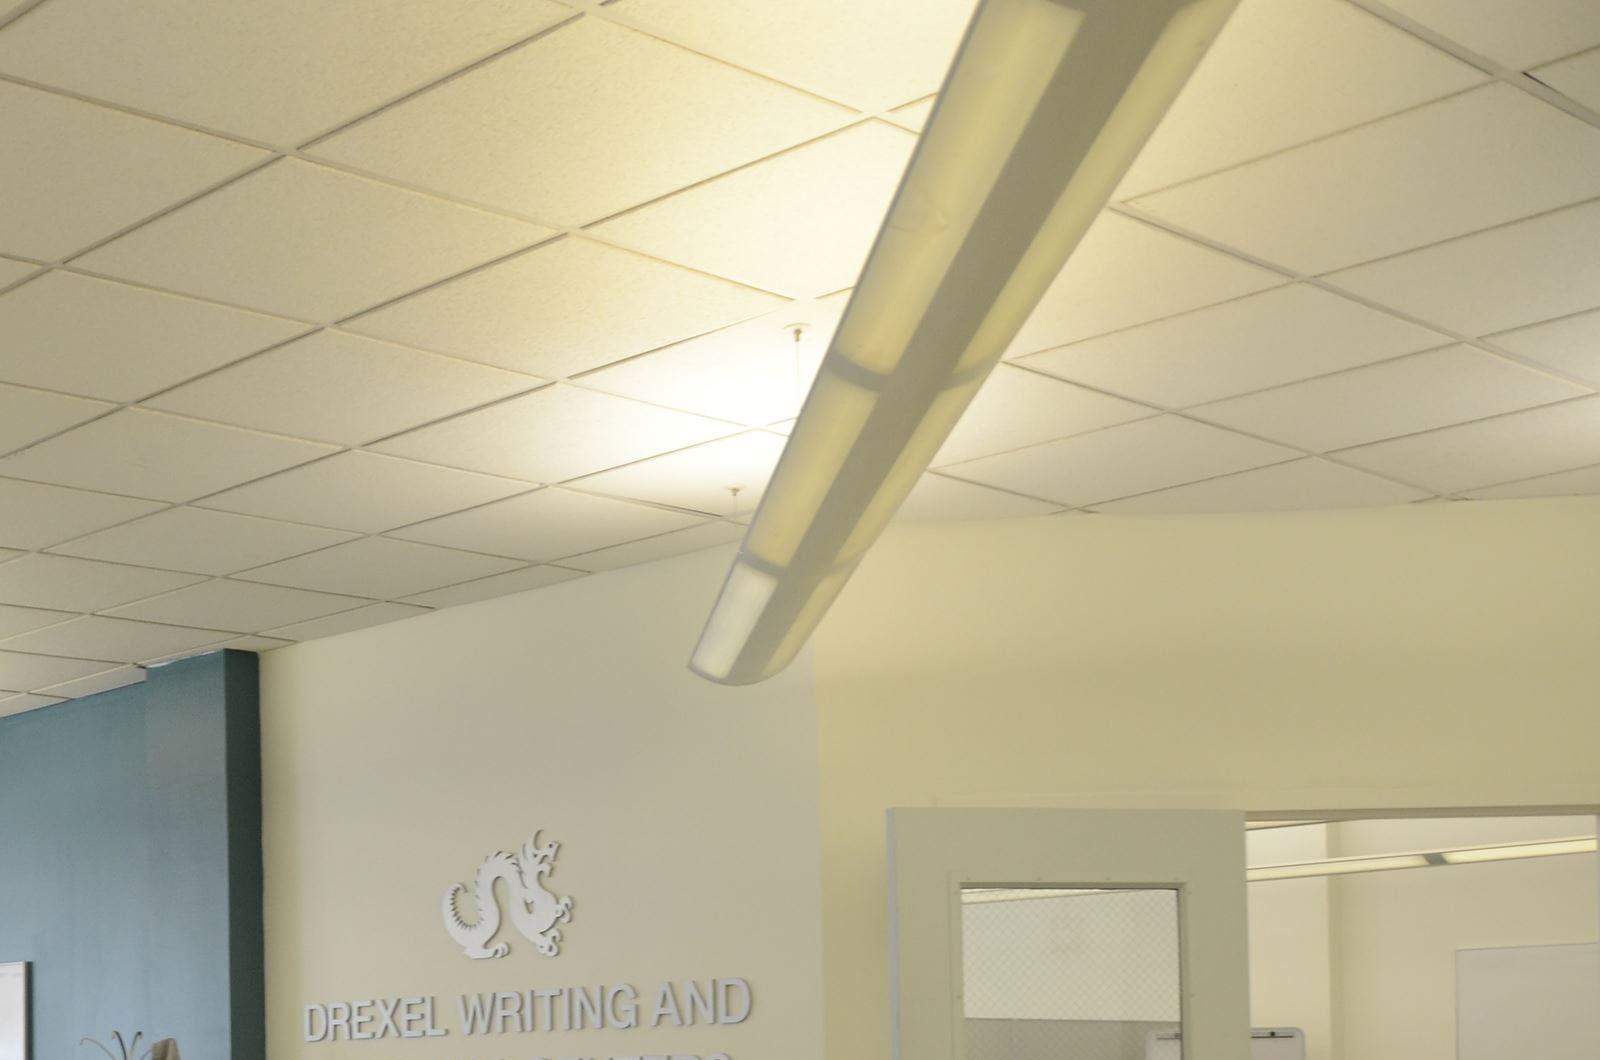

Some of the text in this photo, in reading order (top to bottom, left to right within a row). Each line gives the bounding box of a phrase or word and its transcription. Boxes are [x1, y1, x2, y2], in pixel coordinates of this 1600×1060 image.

[304, 976, 752, 1042] DREXEL WRITING AND
